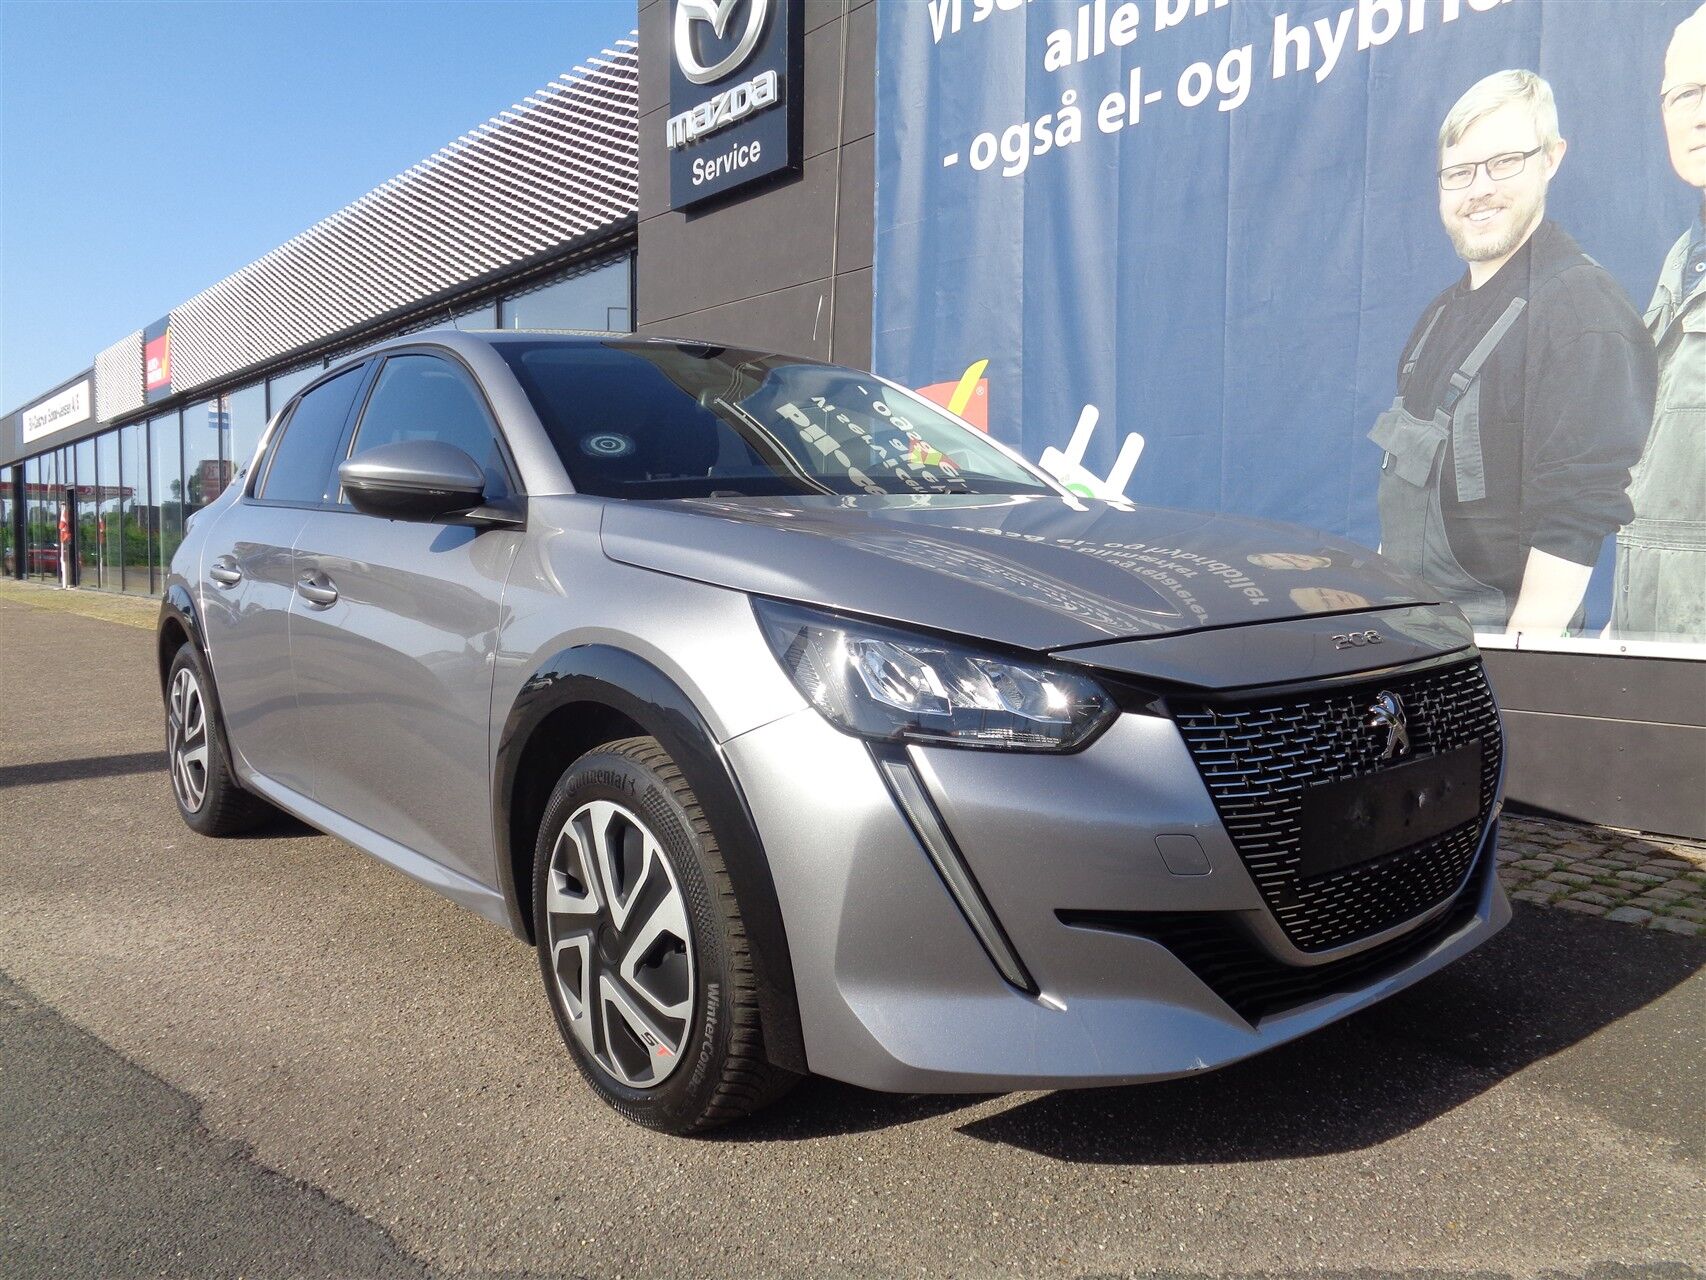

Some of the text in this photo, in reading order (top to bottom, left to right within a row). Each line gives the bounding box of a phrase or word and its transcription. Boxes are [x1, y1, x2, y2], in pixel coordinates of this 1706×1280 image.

[1044, 0, 1140, 73] alle
[968, 89, 1083, 178] også
[1097, 66, 1162, 134] el-
[1176, 43, 1253, 112] og
[692, 140, 761, 186] Service
[1331, 630, 1383, 651] 208
